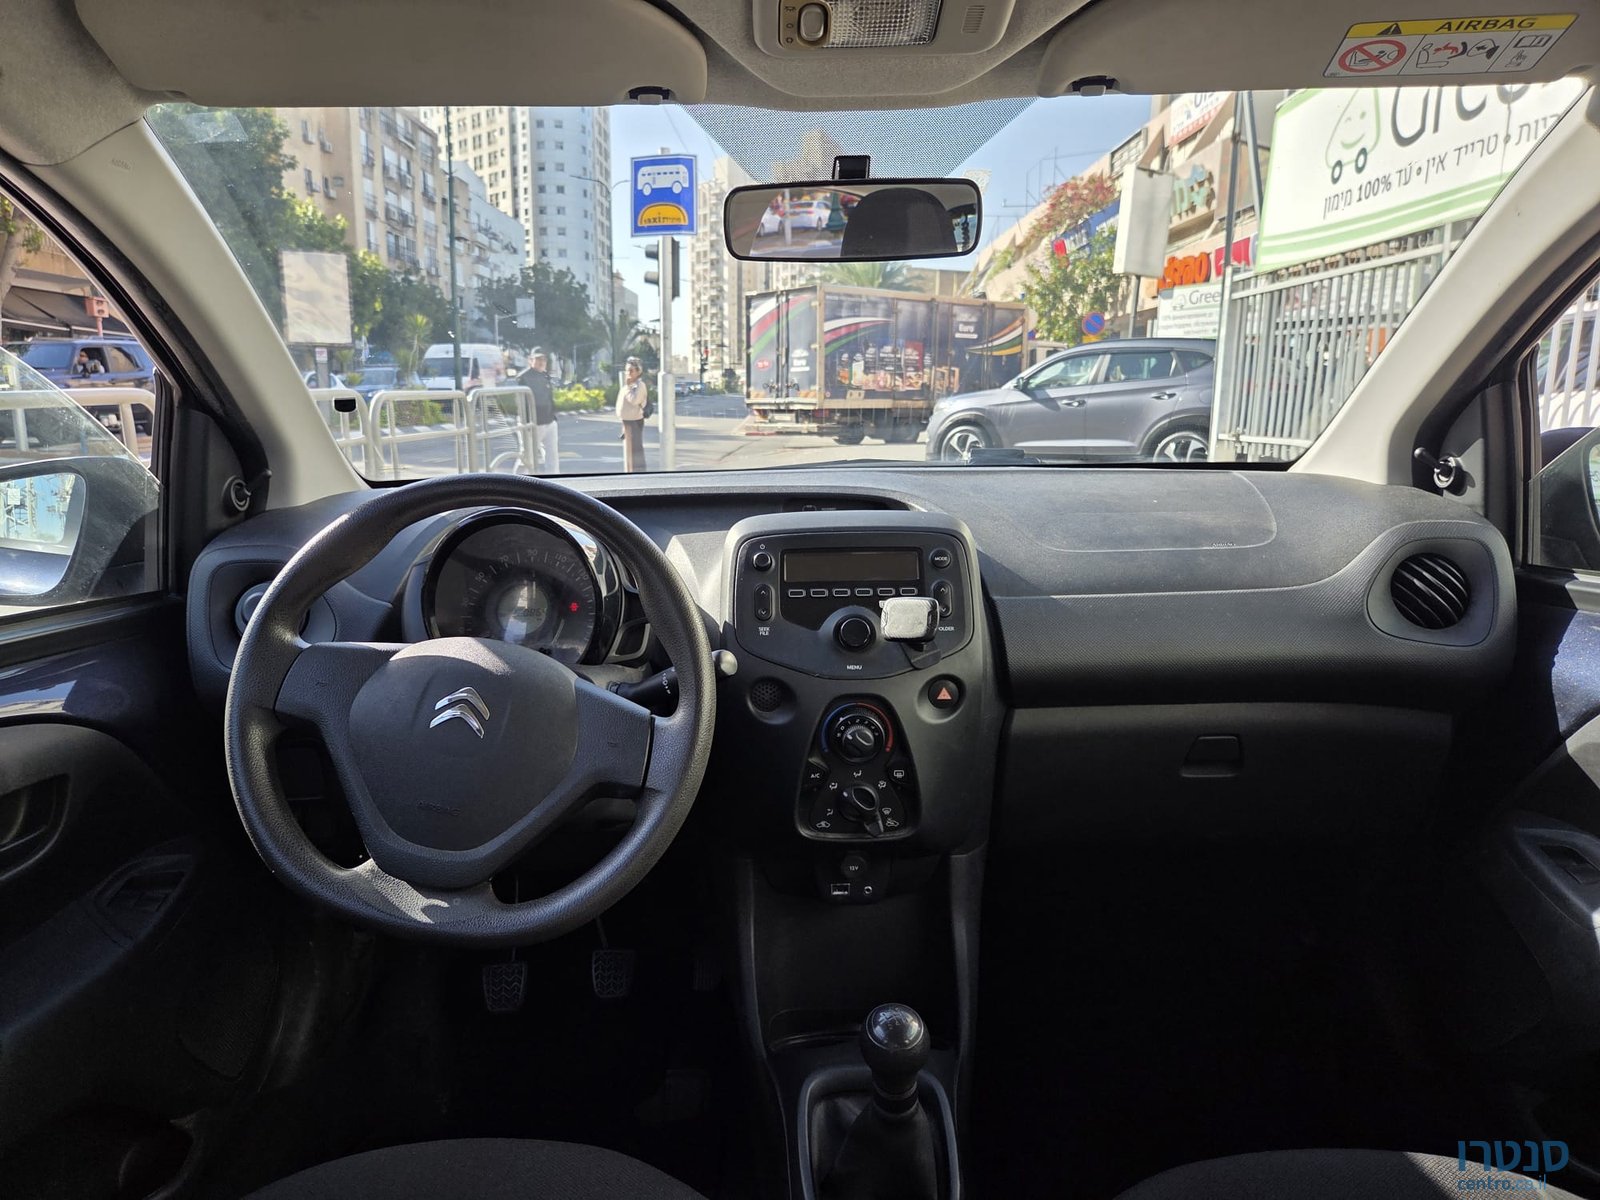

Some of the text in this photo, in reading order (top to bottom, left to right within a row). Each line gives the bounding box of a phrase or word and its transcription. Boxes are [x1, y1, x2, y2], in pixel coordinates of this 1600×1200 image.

[1435, 18, 1536, 32] AIRBAG
[1453, 140, 1498, 165] טרייד
[1395, 166, 1413, 187] עד
[1425, 152, 1448, 184] אין
[1357, 176, 1392, 203] 100%
[1323, 189, 1352, 220] מימון
